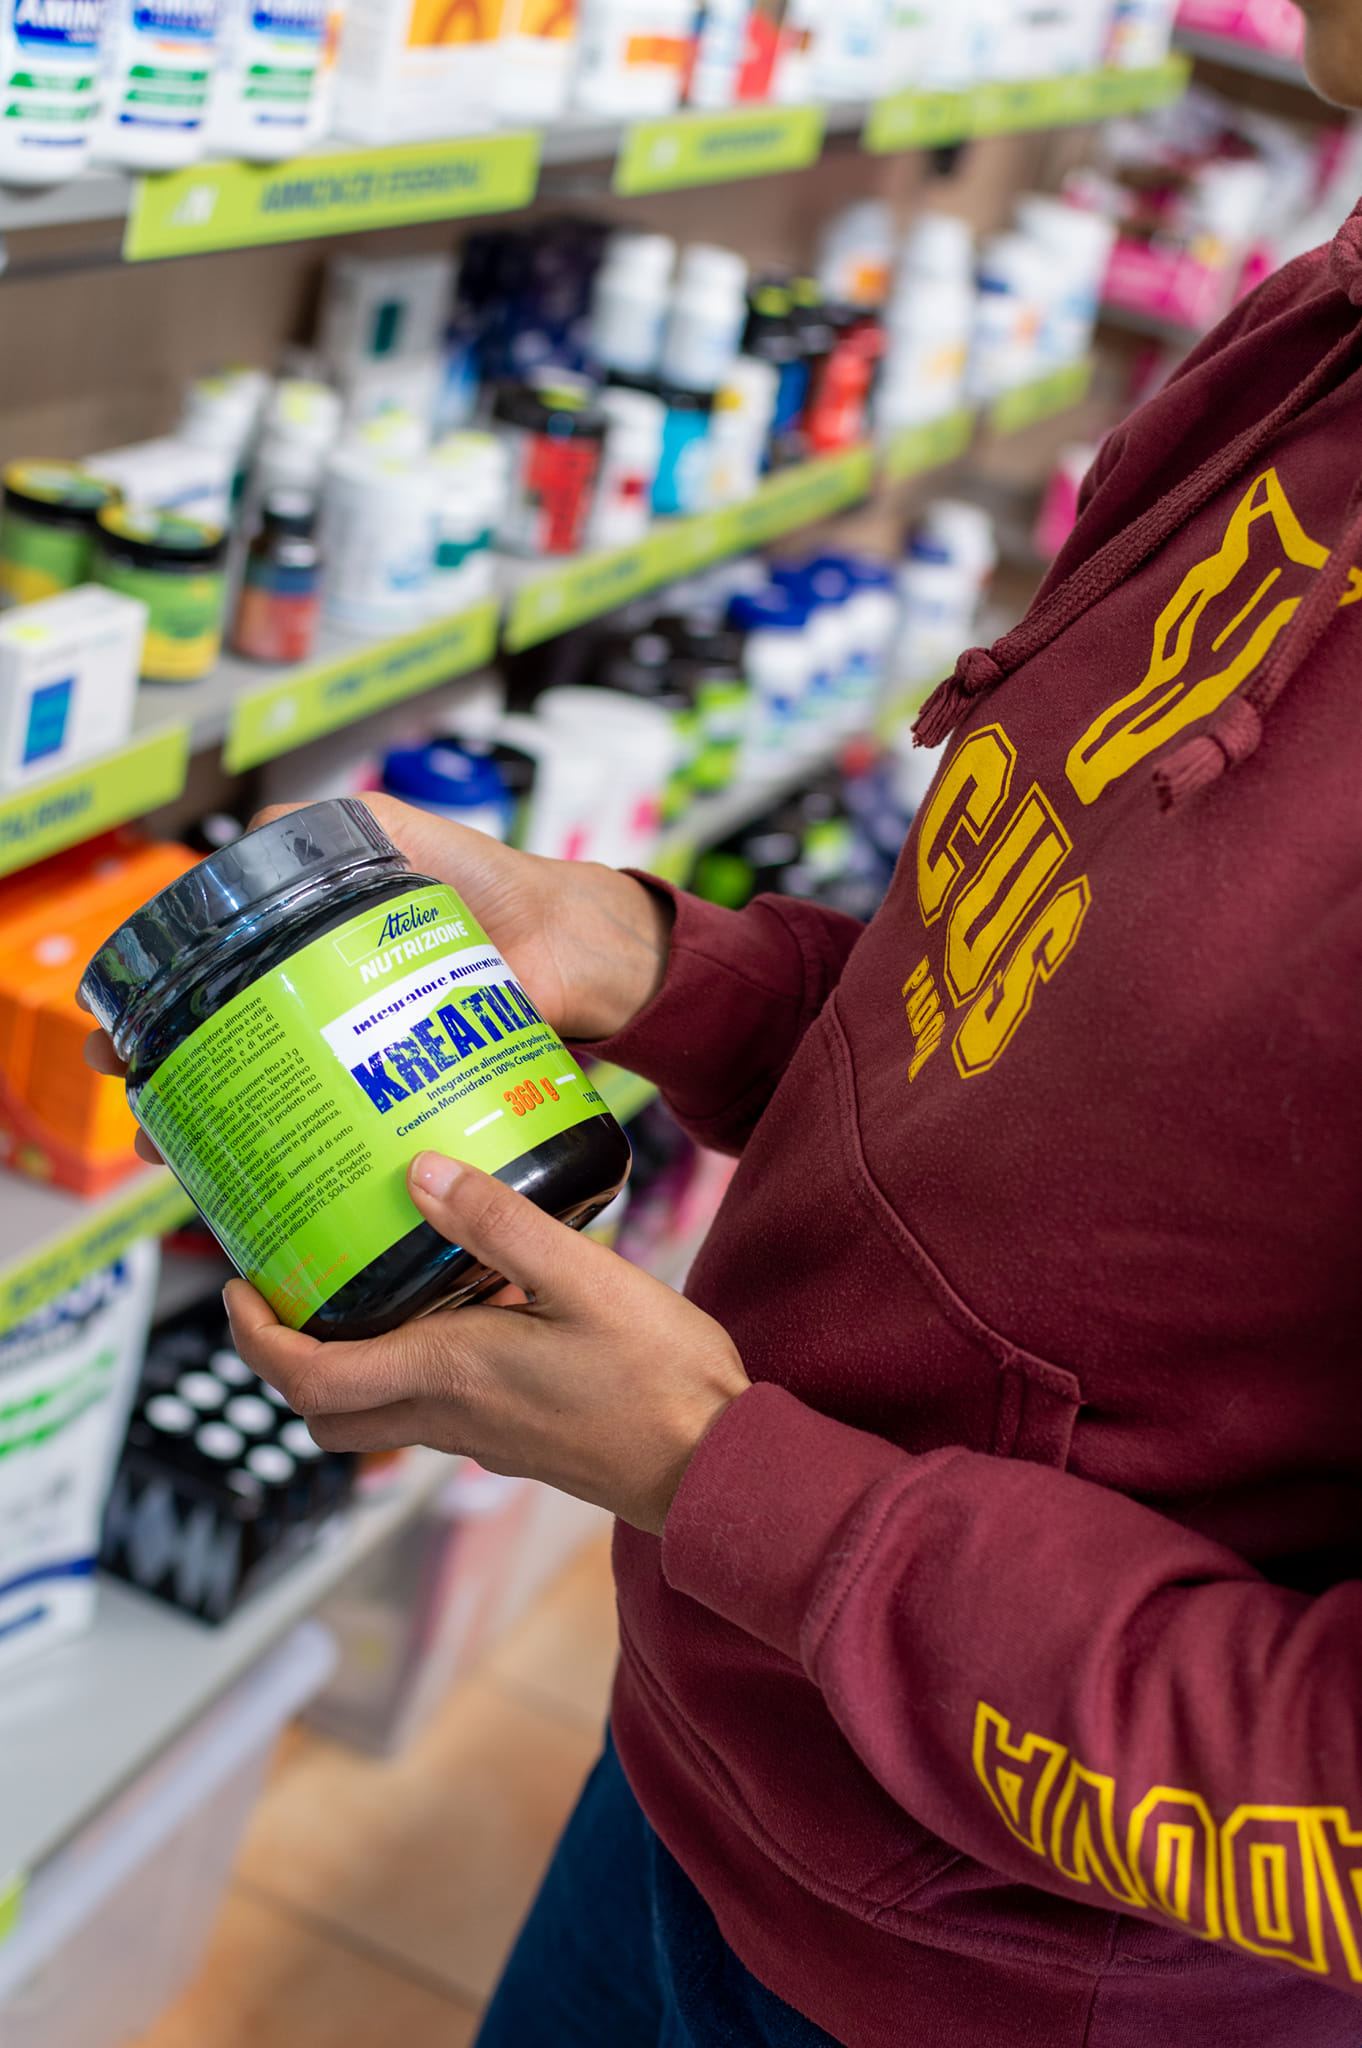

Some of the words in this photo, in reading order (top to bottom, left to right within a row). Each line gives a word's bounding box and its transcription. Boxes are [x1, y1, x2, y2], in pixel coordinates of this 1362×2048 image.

[378, 904, 439, 947] Atelier
[917, 722, 1092, 1079] CUS
[360, 921, 468, 984] NUTRIZIONE
[181, 1057, 190, 1068] un
[188, 1027, 224, 1060] integratore
[223, 996, 262, 1029] alimentare
[353, 977, 448, 1035] Integratore
[175, 1056, 208, 1087] monoidrato.
[206, 1046, 217, 1056] La
[215, 1023, 244, 1049] creatina
[242, 1016, 250, 1025] è
[249, 1004, 267, 1020] utile
[181, 1063, 211, 1097] prestazioni
[210, 1045, 234, 1066] fisiche
[234, 1036, 244, 1046] in
[245, 1021, 263, 1037] caso
[263, 1011, 274, 1022] di
[188, 1082, 208, 1103] elevata
[208, 1055, 237, 1082] intensità
[238, 1049, 246, 1057] e
[245, 1039, 256, 1050] di
[256, 1021, 280, 1041] breve
[207, 1076, 230, 1099] ottiene
[228, 1064, 243, 1078] con
[241, 1030, 286, 1067] l'assunzione
[351, 980, 546, 1114] KREATILA
[426, 1064, 480, 1100] Integratore
[480, 1042, 520, 1069] alimentare
[519, 1040, 528, 1051] in
[204, 1105, 228, 1131] consiglia
[225, 1097, 235, 1108] di
[233, 1073, 266, 1102] assumere
[263, 1061, 281, 1076] fino
[284, 1051, 292, 1059] 3
[291, 1047, 300, 1057] g
[211, 1109, 238, 1138] misurino)
[236, 1103, 244, 1113] al
[243, 1086, 268, 1108] giorno.
[267, 1062, 295, 1086] Versare
[294, 1055, 304, 1064] la
[227, 1112, 253, 1136] naturale.
[250, 1101, 264, 1113] Per
[262, 1088, 281, 1104] l'uso
[279, 1064, 311, 1090] sportivo
[229, 1118, 260, 1148] consentita
[257, 1085, 301, 1120] l'assunzione
[299, 1072, 317, 1087] fino
[273, 1094, 306, 1123] prodotto
[306, 1081, 322, 1096] non
[396, 1107, 439, 1137] Creatina
[438, 1074, 493, 1110] Monoidrato
[492, 1060, 516, 1078] 100%
[503, 1079, 544, 1117] 360
[539, 1077, 560, 1102] g
[251, 1169, 266, 1184] Non
[264, 1145, 293, 1172] utilizzare
[290, 1139, 300, 1148] in
[299, 1109, 342, 1144] gravidanza,
[261, 1149, 270, 1159] di
[269, 1128, 297, 1153] creatina
[294, 1122, 302, 1131] il
[301, 1098, 335, 1128] prodotto
[250, 1170, 281, 1200] consigliate.
[256, 1187, 277, 1209] portata
[274, 1175, 287, 1189] dei
[287, 1151, 317, 1178] bambini
[316, 1145, 324, 1155] al
[322, 1138, 333, 1149] di
[332, 1124, 353, 1142] sotto
[281, 1180, 315, 1213] considerati
[314, 1165, 335, 1184] come
[335, 1140, 366, 1167] sostituti
[287, 1214, 309, 1236] utilizza
[305, 1198, 330, 1218] LATTE,
[346, 1164, 372, 1185] UOVO.
[288, 1205, 303, 1220] sano
[302, 1194, 316, 1207] stile
[314, 1186, 324, 1196] di
[337, 1150, 372, 1178] Prodotto
